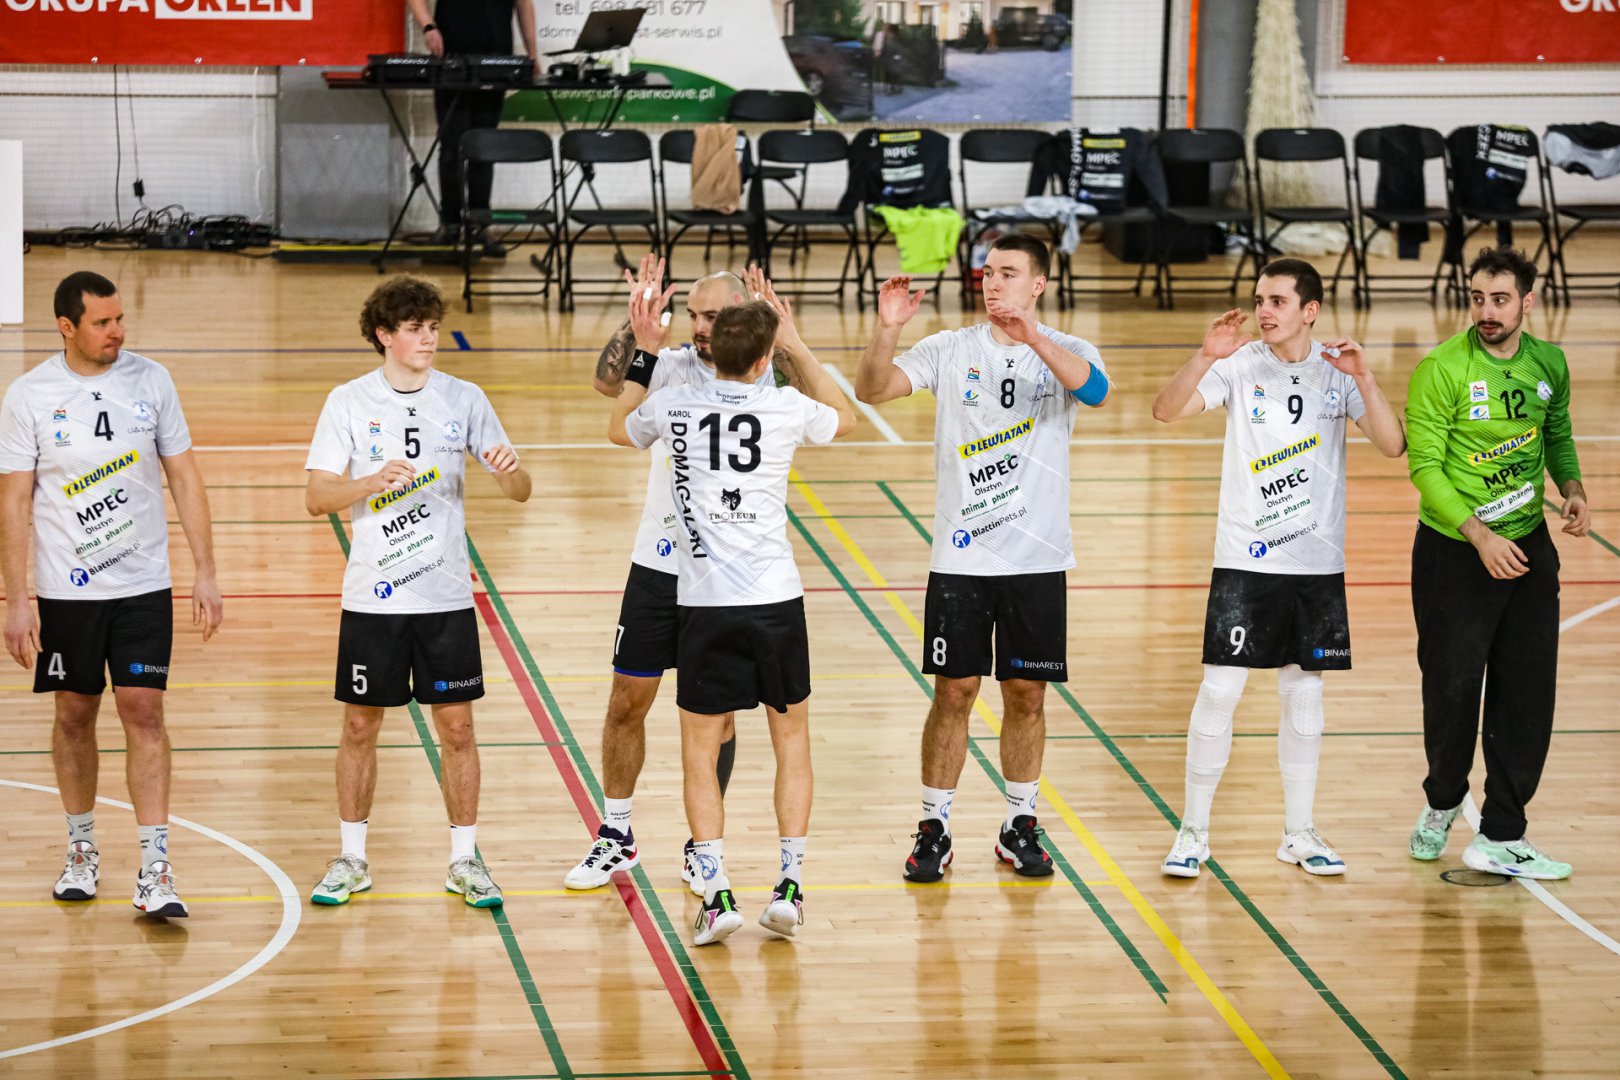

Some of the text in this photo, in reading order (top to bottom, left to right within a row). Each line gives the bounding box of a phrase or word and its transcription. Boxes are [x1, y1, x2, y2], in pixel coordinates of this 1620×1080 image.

[1000, 378, 1015, 409] 8
[1500, 388, 1528, 419] 12
[667, 409, 692, 419] KAROL
[1287, 394, 1304, 425] 9
[94, 411, 114, 441] 4
[977, 421, 1031, 452] LEWIATAN
[404, 427, 421, 460] 5
[698, 412, 762, 474] 13
[1267, 436, 1317, 467] LEWIATAN
[79, 453, 134, 490] LEWIATAN
[968, 455, 1019, 487] MPEC
[1260, 468, 1310, 500] MPEC
[670, 422, 708, 558] DOMAGALSKI
[960, 485, 1020, 516] animal pharma
[974, 481, 1003, 496] Olsztyn
[1266, 493, 1294, 508] Olsztyn
[1476, 485, 1533, 518] animal pharma
[76, 488, 129, 526] MPEC
[381, 503, 431, 538] MPEC
[971, 506, 1028, 538] BlattinPets.pl
[1254, 498, 1311, 527] animal pharma
[84, 516, 114, 535] Olsztyn
[104, 519, 134, 542] pharma
[389, 529, 416, 546] Olsztyn
[1267, 521, 1319, 549] BlattinPets.pl
[377, 534, 434, 567] animal pharma
[392, 556, 445, 588] BlattinPets.pl
[932, 636, 947, 666] 8
[1230, 625, 1246, 656] 9
[47, 652, 67, 681] 4
[352, 663, 368, 695] 5
[1024, 660, 1065, 671] BINAREST
